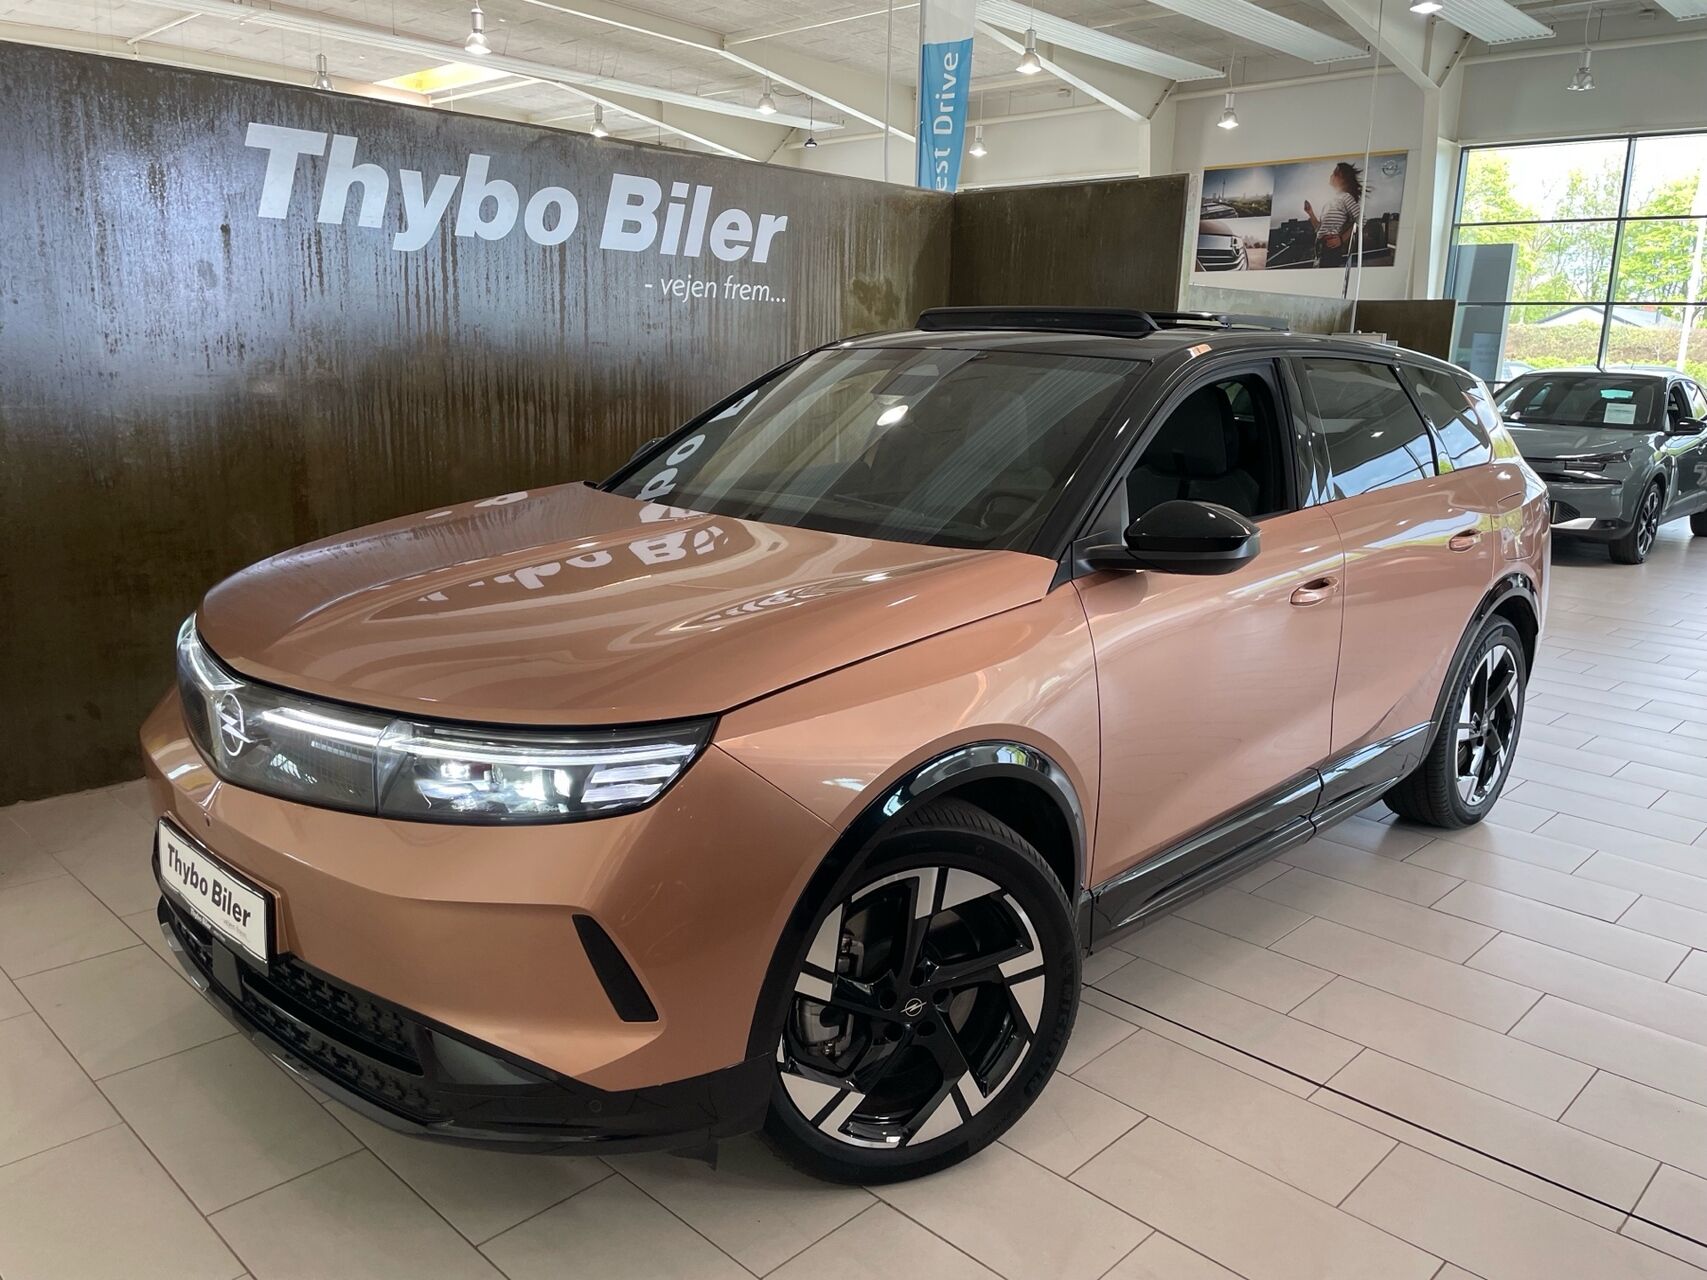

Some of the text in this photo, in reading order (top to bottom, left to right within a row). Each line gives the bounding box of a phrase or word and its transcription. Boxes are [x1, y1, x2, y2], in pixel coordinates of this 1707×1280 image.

[933, 51, 959, 135] Drive
[245, 122, 788, 263] Thybo Biler
[660, 274, 718, 303] vejen
[723, 275, 786, 303] frem...
[167, 842, 208, 897] Thybo
[211, 878, 251, 927] Biler
